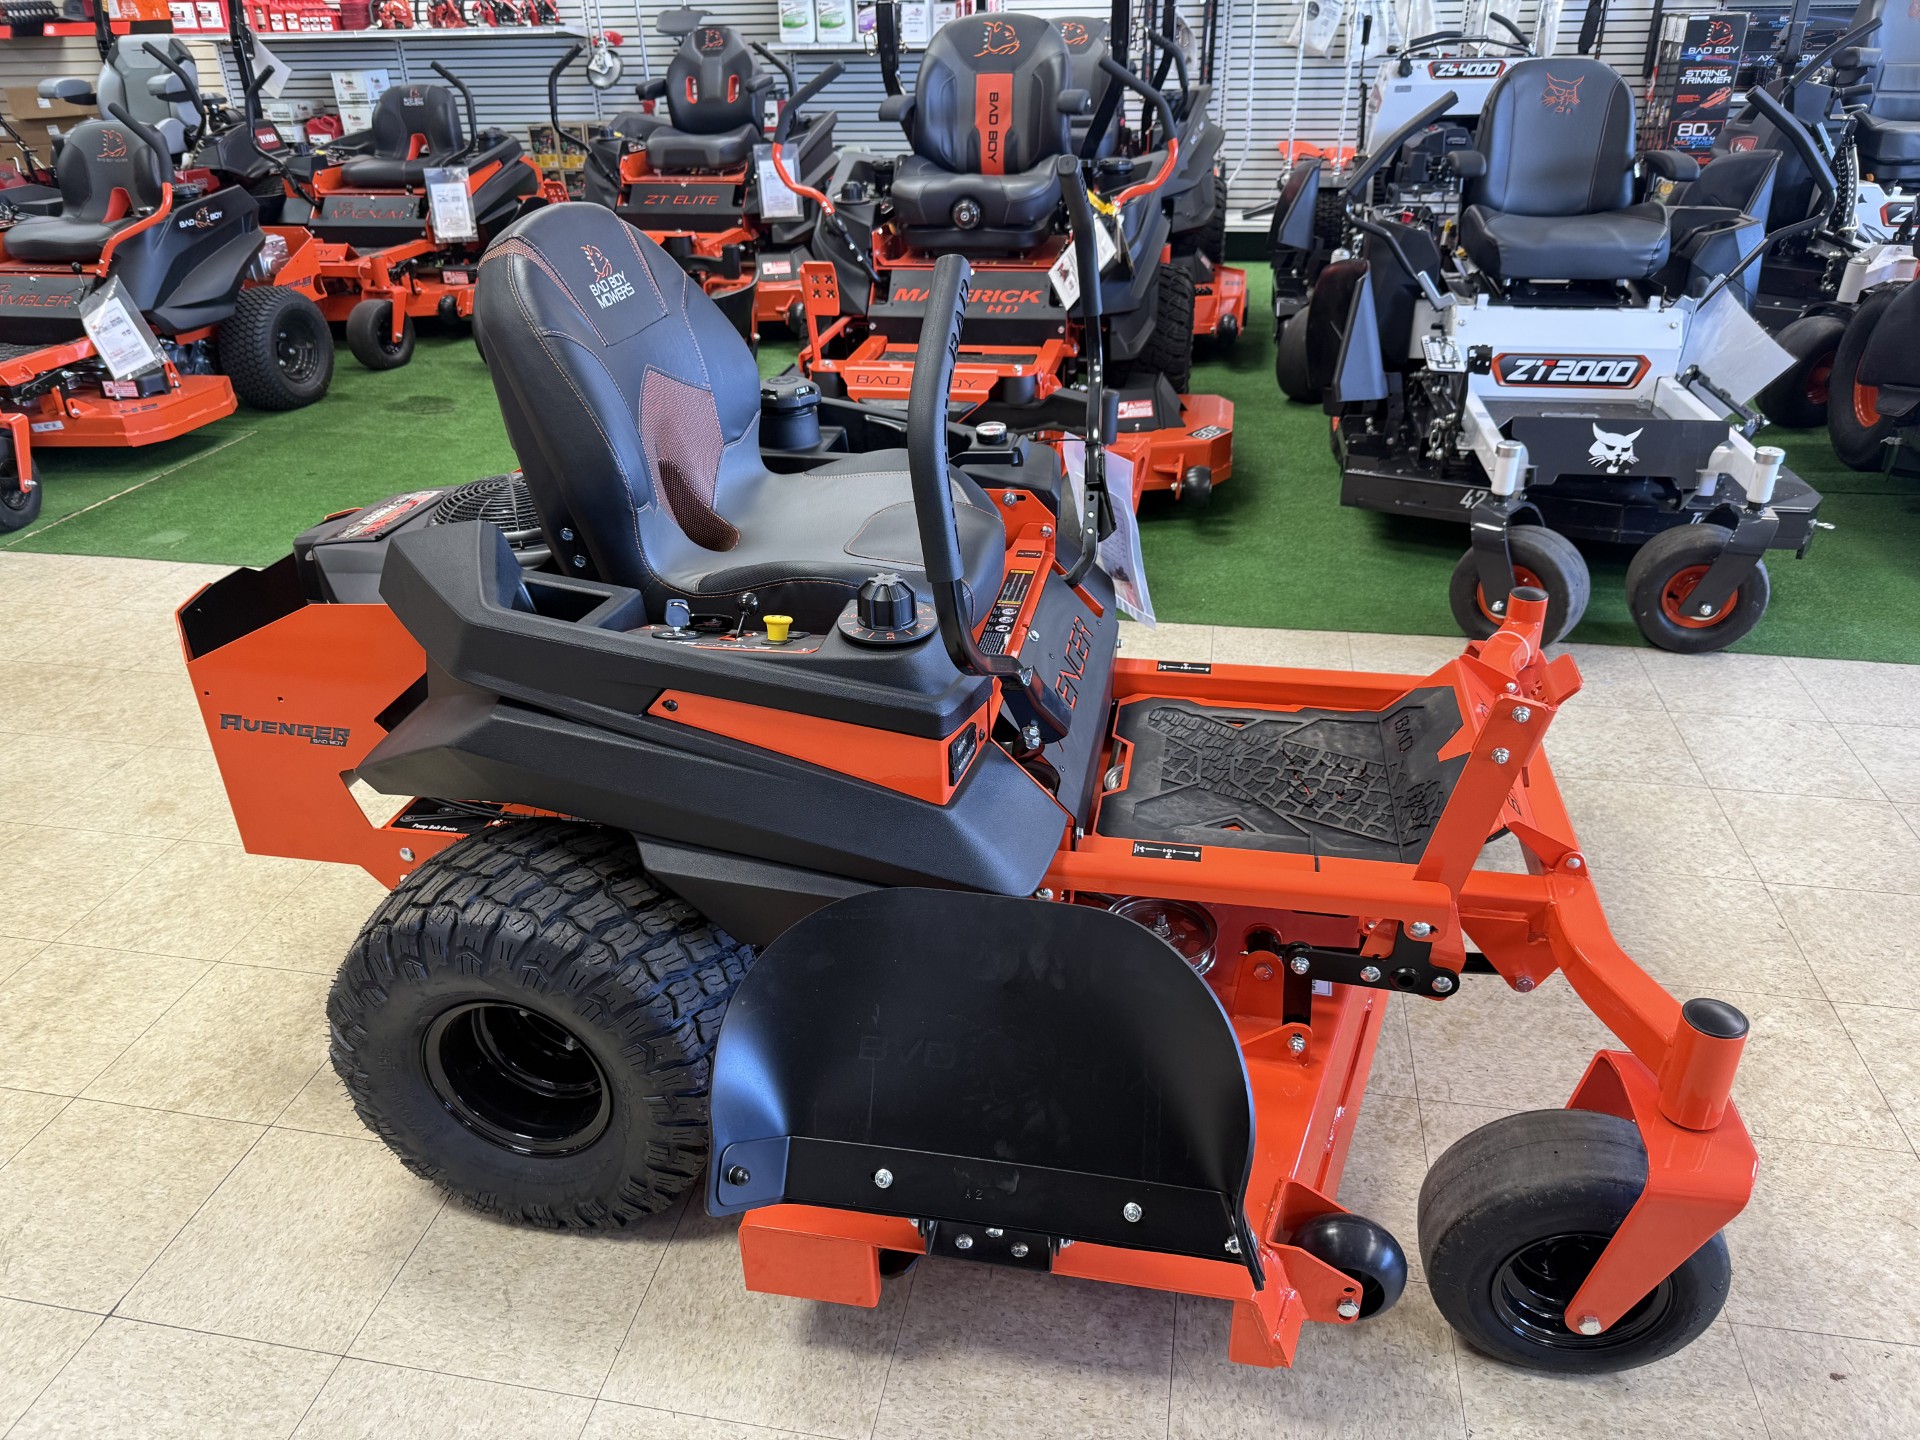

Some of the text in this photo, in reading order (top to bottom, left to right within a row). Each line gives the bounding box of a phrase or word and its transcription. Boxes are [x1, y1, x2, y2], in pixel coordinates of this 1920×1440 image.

[1688, 46, 1740, 55] BAD BOY
[1435, 62, 1501, 77] ZS4000
[1685, 69, 1729, 78] STRING
[1680, 76, 1732, 85] TRIMMER
[988, 92, 999, 164] BAD BOY
[644, 195, 720, 205] ZT ELITE
[179, 210, 223, 229] BAD BOY
[589, 270, 627, 297] BAD BOY
[595, 282, 635, 309] MOWERS
[893, 288, 1044, 304] MAERICK
[1506, 358, 1639, 383] ZT2000
[856, 374, 900, 385] BAD
[1055, 615, 1094, 712] ENGER
